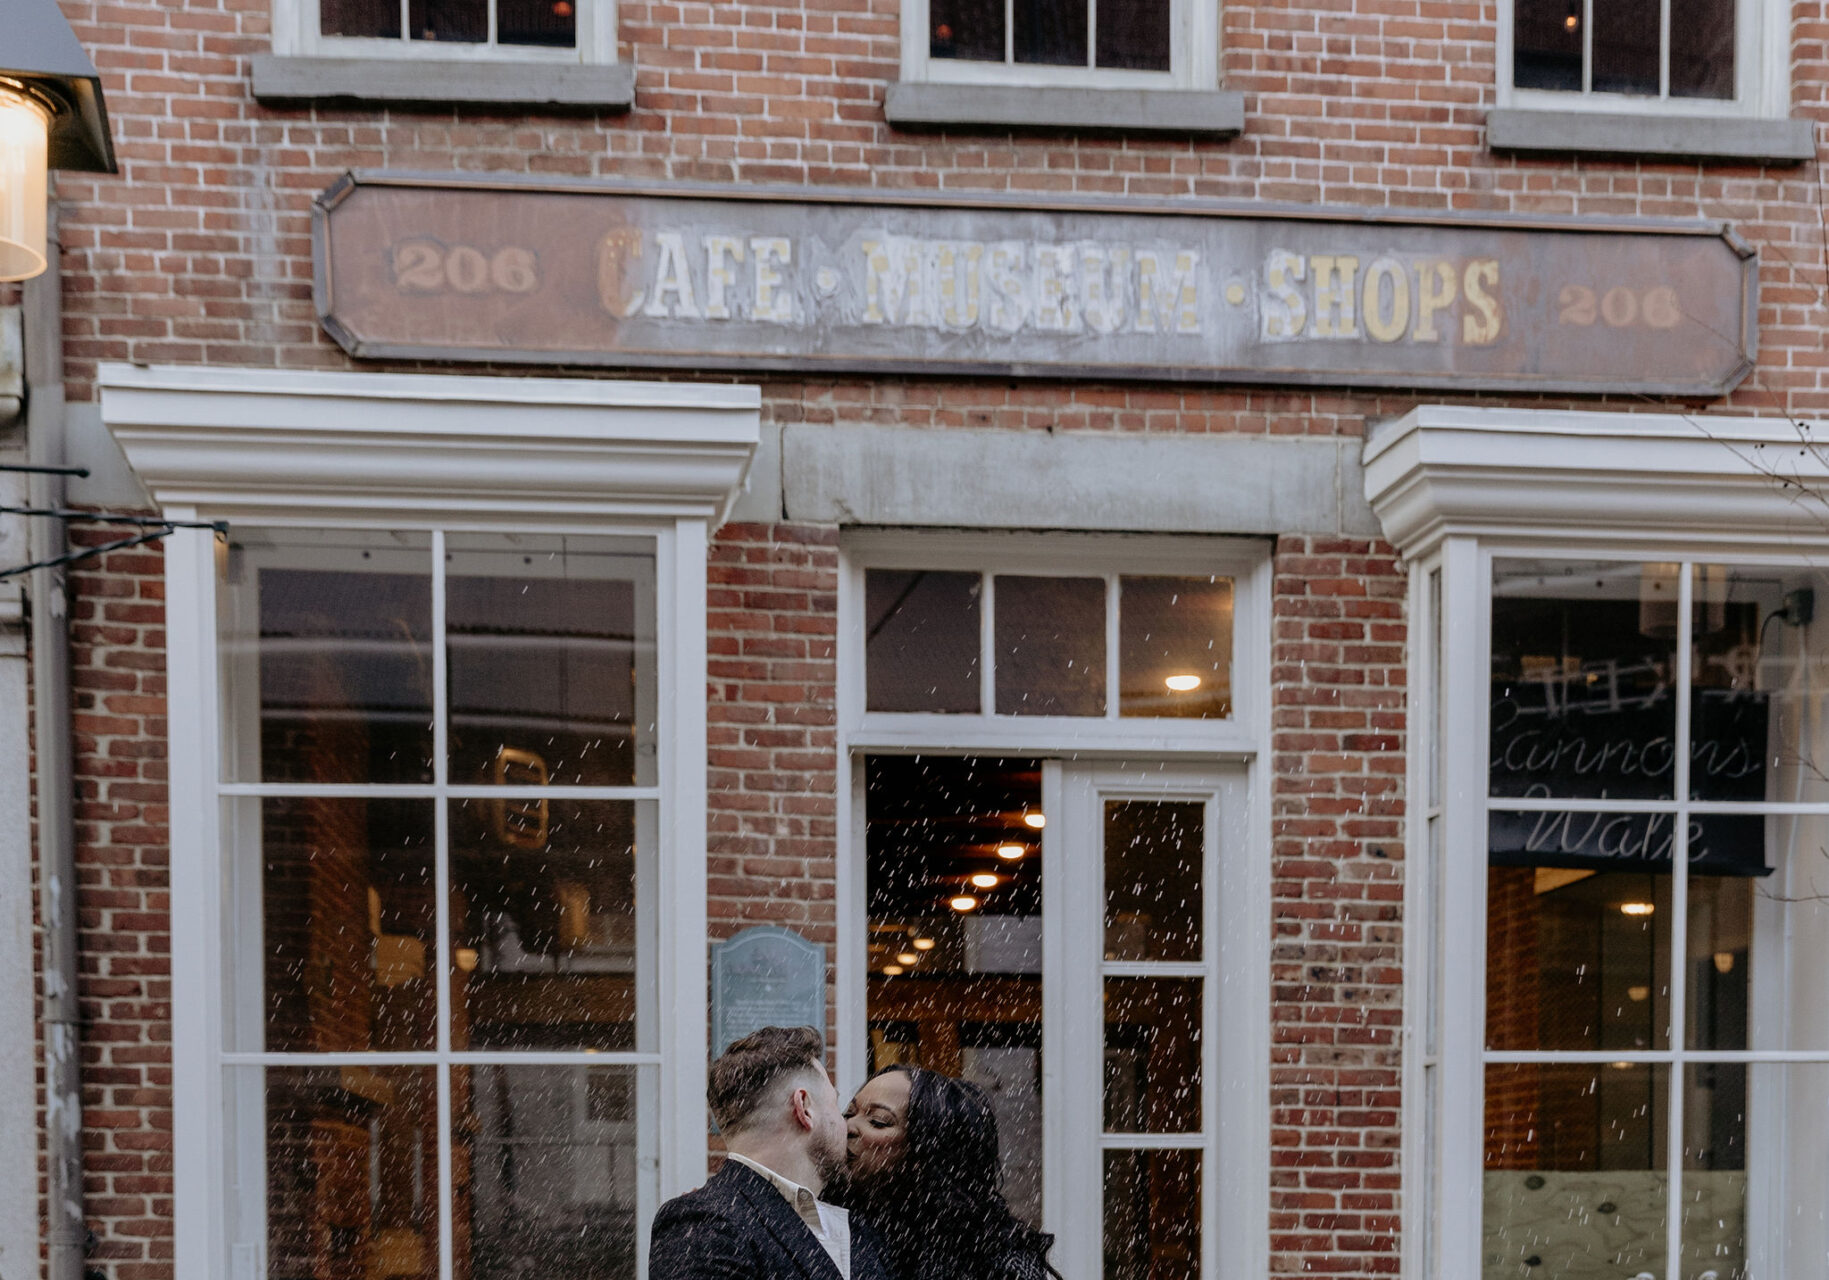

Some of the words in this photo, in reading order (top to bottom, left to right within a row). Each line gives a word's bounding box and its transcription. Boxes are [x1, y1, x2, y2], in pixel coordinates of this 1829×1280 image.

[399, 244, 537, 294] 206
[599, 227, 792, 322] CAFE
[862, 241, 1203, 333] MUSEUM
[1267, 250, 1501, 348] SHOPS
[1558, 284, 1681, 330] 206
